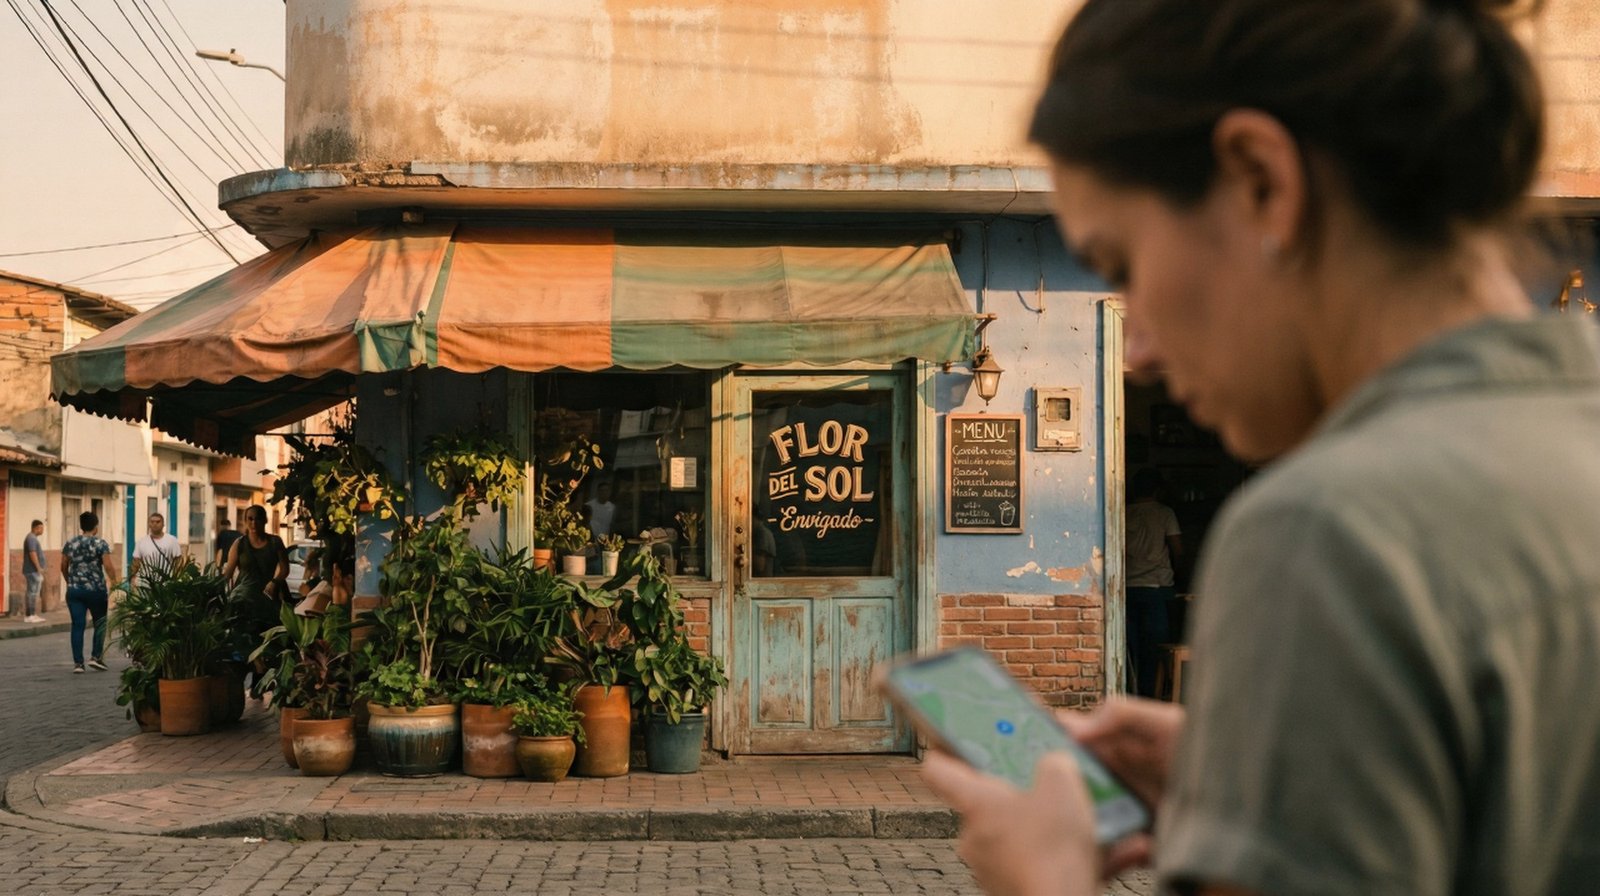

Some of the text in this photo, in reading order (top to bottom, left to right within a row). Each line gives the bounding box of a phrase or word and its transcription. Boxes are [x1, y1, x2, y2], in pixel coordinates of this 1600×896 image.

[769, 420, 869, 465] FLOR
[962, 422, 1005, 439] MENU
[769, 465, 874, 503] DEL SOL
